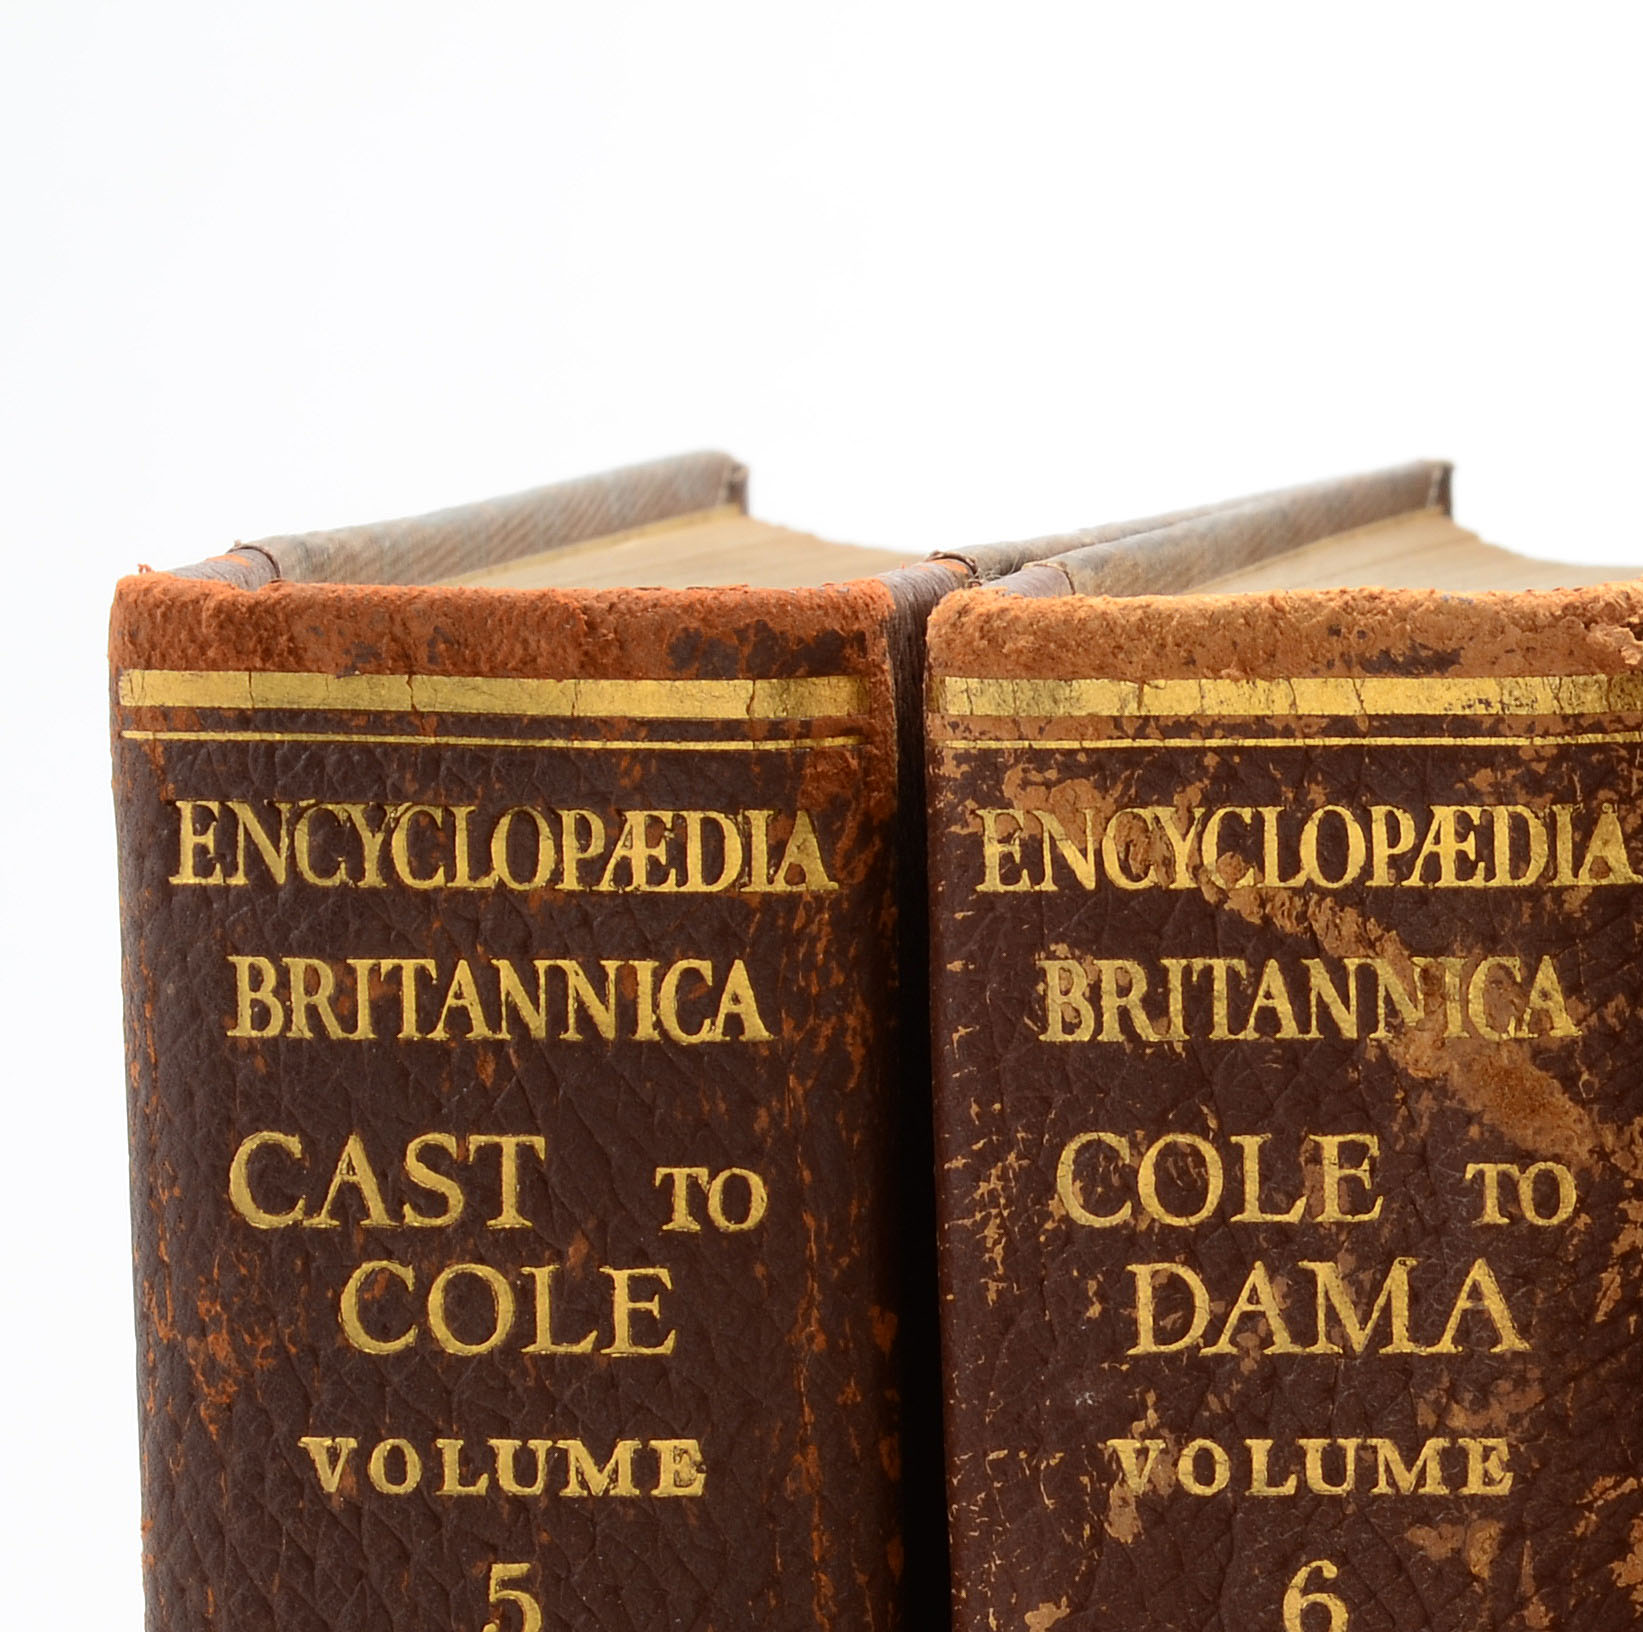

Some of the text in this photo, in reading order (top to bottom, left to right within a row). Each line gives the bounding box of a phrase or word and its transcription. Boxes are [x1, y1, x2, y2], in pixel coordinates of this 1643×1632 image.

[169, 800, 840, 894] ENCYCLOPÆDIA
[975, 803, 1643, 894] ENCYCLOPÆDIA
[226, 956, 774, 1044] BRITANNICA
[1037, 955, 1582, 1042] BRITANNICA
[229, 1132, 768, 1233] CAST TO
[1055, 1132, 1578, 1227] COLE TO
[338, 1262, 677, 1357] COLE
[1125, 1258, 1530, 1356] DAMA
[299, 1437, 705, 1498] VOLUME
[1109, 1436, 1514, 1497] VOLUME
